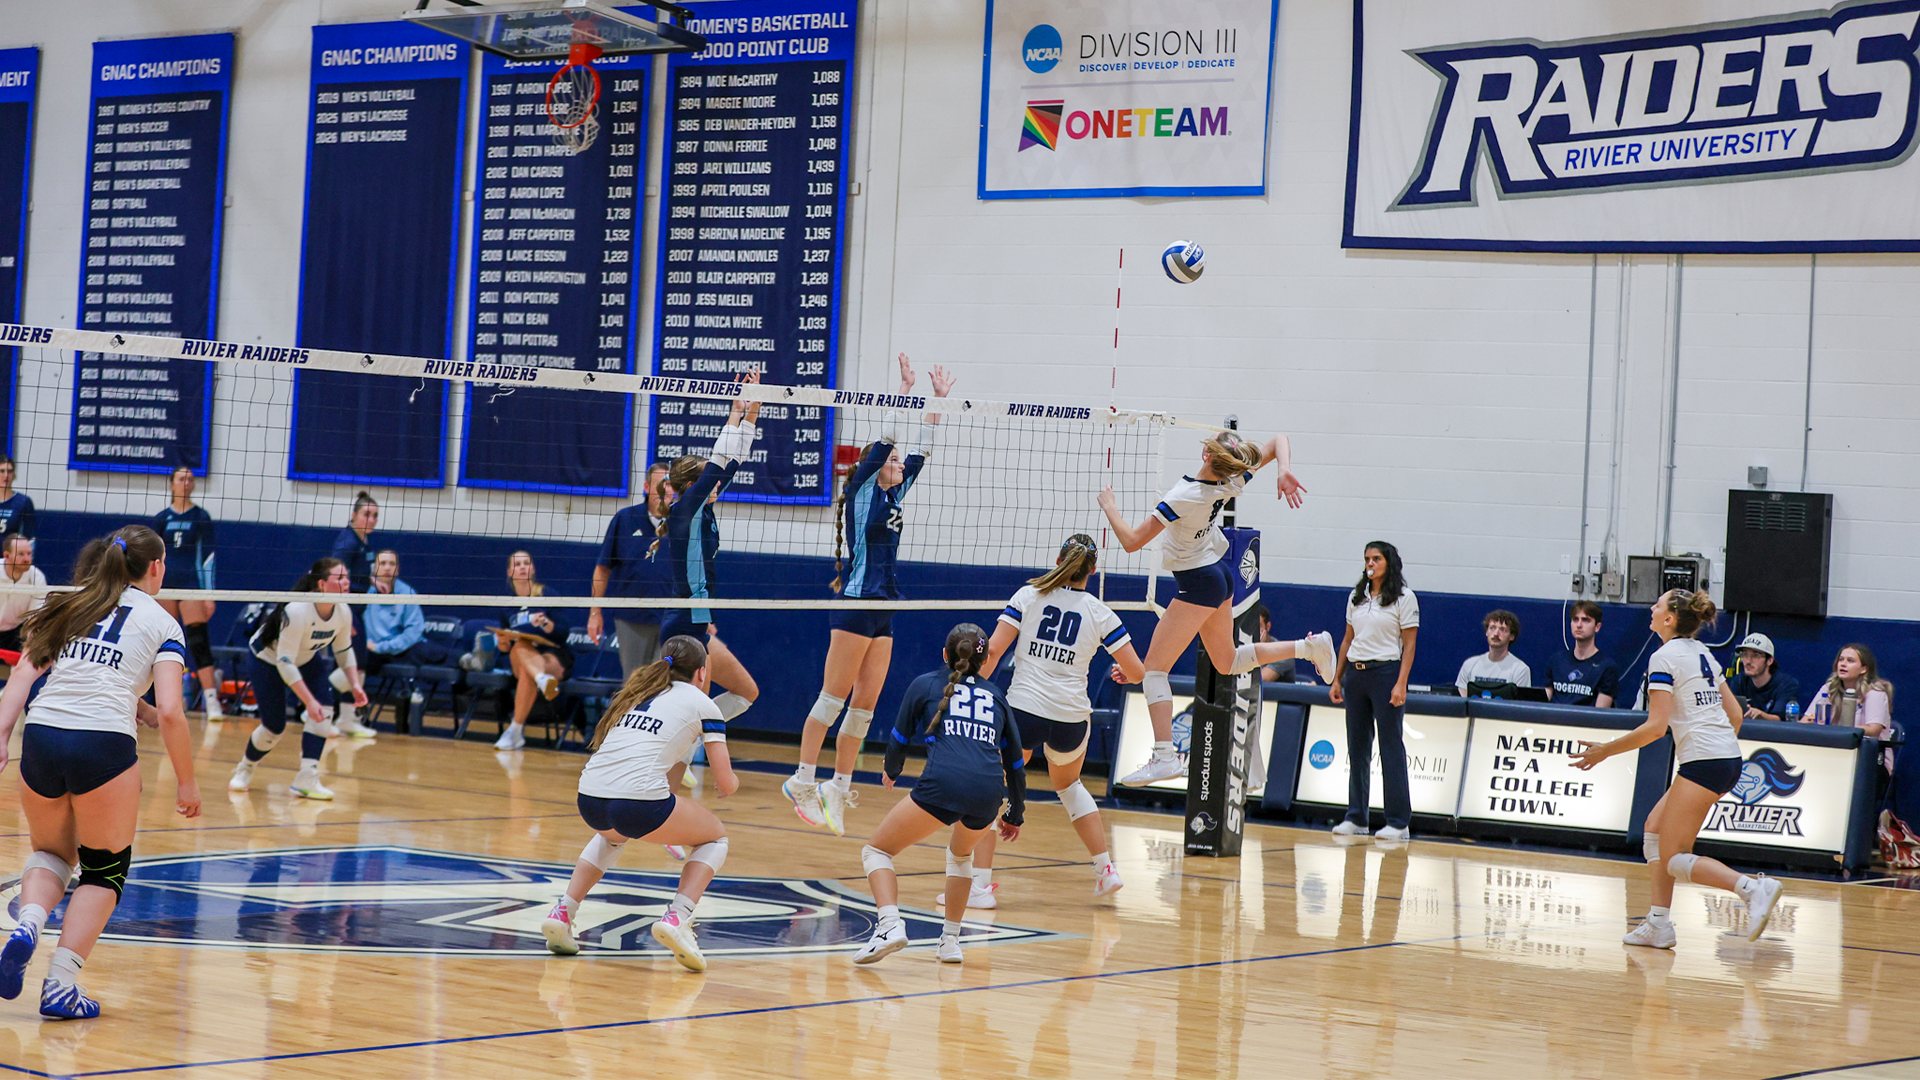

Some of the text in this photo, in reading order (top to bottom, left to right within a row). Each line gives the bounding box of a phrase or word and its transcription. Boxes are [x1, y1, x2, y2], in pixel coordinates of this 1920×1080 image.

[752, 12, 848, 32] BASKETBALL
[738, 40, 785, 57] POINT
[789, 38, 829, 55] CLUB
[1080, 28, 1236, 59] DIVISION III
[322, 43, 457, 67] GNAC CHAMPIONS
[1026, 48, 1060, 62] NCAA
[101, 58, 220, 81] GNAC CHAMPIONS
[1080, 59, 1235, 72] DISCOVER DEVELOP DEDICATE
[680, 71, 840, 88] 1984 MOE McCARTHY 1,088
[342, 91, 367, 103] MEN'S
[368, 89, 415, 102] VOLLEYBALL
[679, 94, 838, 110] 1984 MAGGIE MOORE 1,056
[1420, 12, 1920, 195] RAIDERS
[341, 111, 367, 123] MEN'S
[367, 109, 408, 122] LACROSSE
[678, 116, 836, 131] 1985 DEB VANDER-HEYDEN 1,158
[341, 131, 367, 142] MEN'S
[367, 130, 407, 142] LACROSSE
[676, 138, 836, 153] 1987 DONNA FERRIE 1,048
[1564, 128, 1797, 171] RIVIER UNIVERSITY
[486, 166, 633, 179] 2002 DAN CARUSO 1,091
[675, 161, 834, 174] 1993 JARI WILLIAMS 1,439
[485, 187, 632, 199] 2003 AARON LOPEZ 1,014
[673, 183, 833, 196] 1993 APRIL POULSEN 1,116
[672, 206, 831, 219] 1994 MICHELLE SWALLOW 1,014
[507, 229, 526, 240] JEFF
[527, 229, 575, 241] CARPENTER
[605, 229, 629, 242] 1,532
[670, 228, 831, 241] 1998 SABRINA MADELINE 1,195
[506, 250, 532, 261] LANCE
[534, 250, 566, 262] BISSON
[603, 251, 628, 263] 1,223
[669, 250, 830, 263] 2007 AMANDA KNOWLES 1,237
[668, 272, 828, 286] 2010 BLAIR CARPENTER 1,228
[667, 293, 827, 308] 2010 JESS MELLEN 1,246
[665, 315, 826, 330] 2010 MONICA WHITE 1,033
[181, 340, 309, 365] RIVIER RAIDERS
[664, 337, 688, 349] 2012
[739, 339, 775, 351] PURCELL
[798, 340, 825, 353] 1,166
[423, 359, 538, 382] RIVIER RAIDERS
[662, 359, 687, 371] 2015
[692, 360, 726, 372] DEANNA
[797, 362, 824, 376] 2,192
[640, 378, 743, 396] RIVIER RAIDERS
[833, 391, 926, 409] RIVIER RAIDERS
[661, 402, 685, 414] 2017
[689, 403, 729, 416] SAVANNA
[796, 407, 820, 420] 1,181
[1007, 403, 1091, 419] RIVIER RAIDERS
[659, 424, 684, 436] 2019
[794, 429, 820, 442] 1,740
[658, 445, 682, 458] 2025
[794, 474, 817, 488] 1,192
[1037, 605, 1082, 647] 20
[60, 641, 123, 670] RIVIER
[1028, 642, 1076, 665] RIVIER
[1699, 654, 1715, 687] 4
[1553, 681, 1593, 696] TOGETHER.
[950, 684, 994, 724] 22
[614, 714, 663, 735] IVIER
[944, 719, 996, 746] RIVIER
[1201, 721, 1213, 801] sports imports
[1311, 754, 1333, 763] NCAA
[1433, 757, 1447, 774] III
[1494, 755, 1539, 773] IS A
[1490, 776, 1593, 798] COLLEGE
[1488, 796, 1564, 817] TOWN.
[1705, 802, 1803, 835] RIVIER
